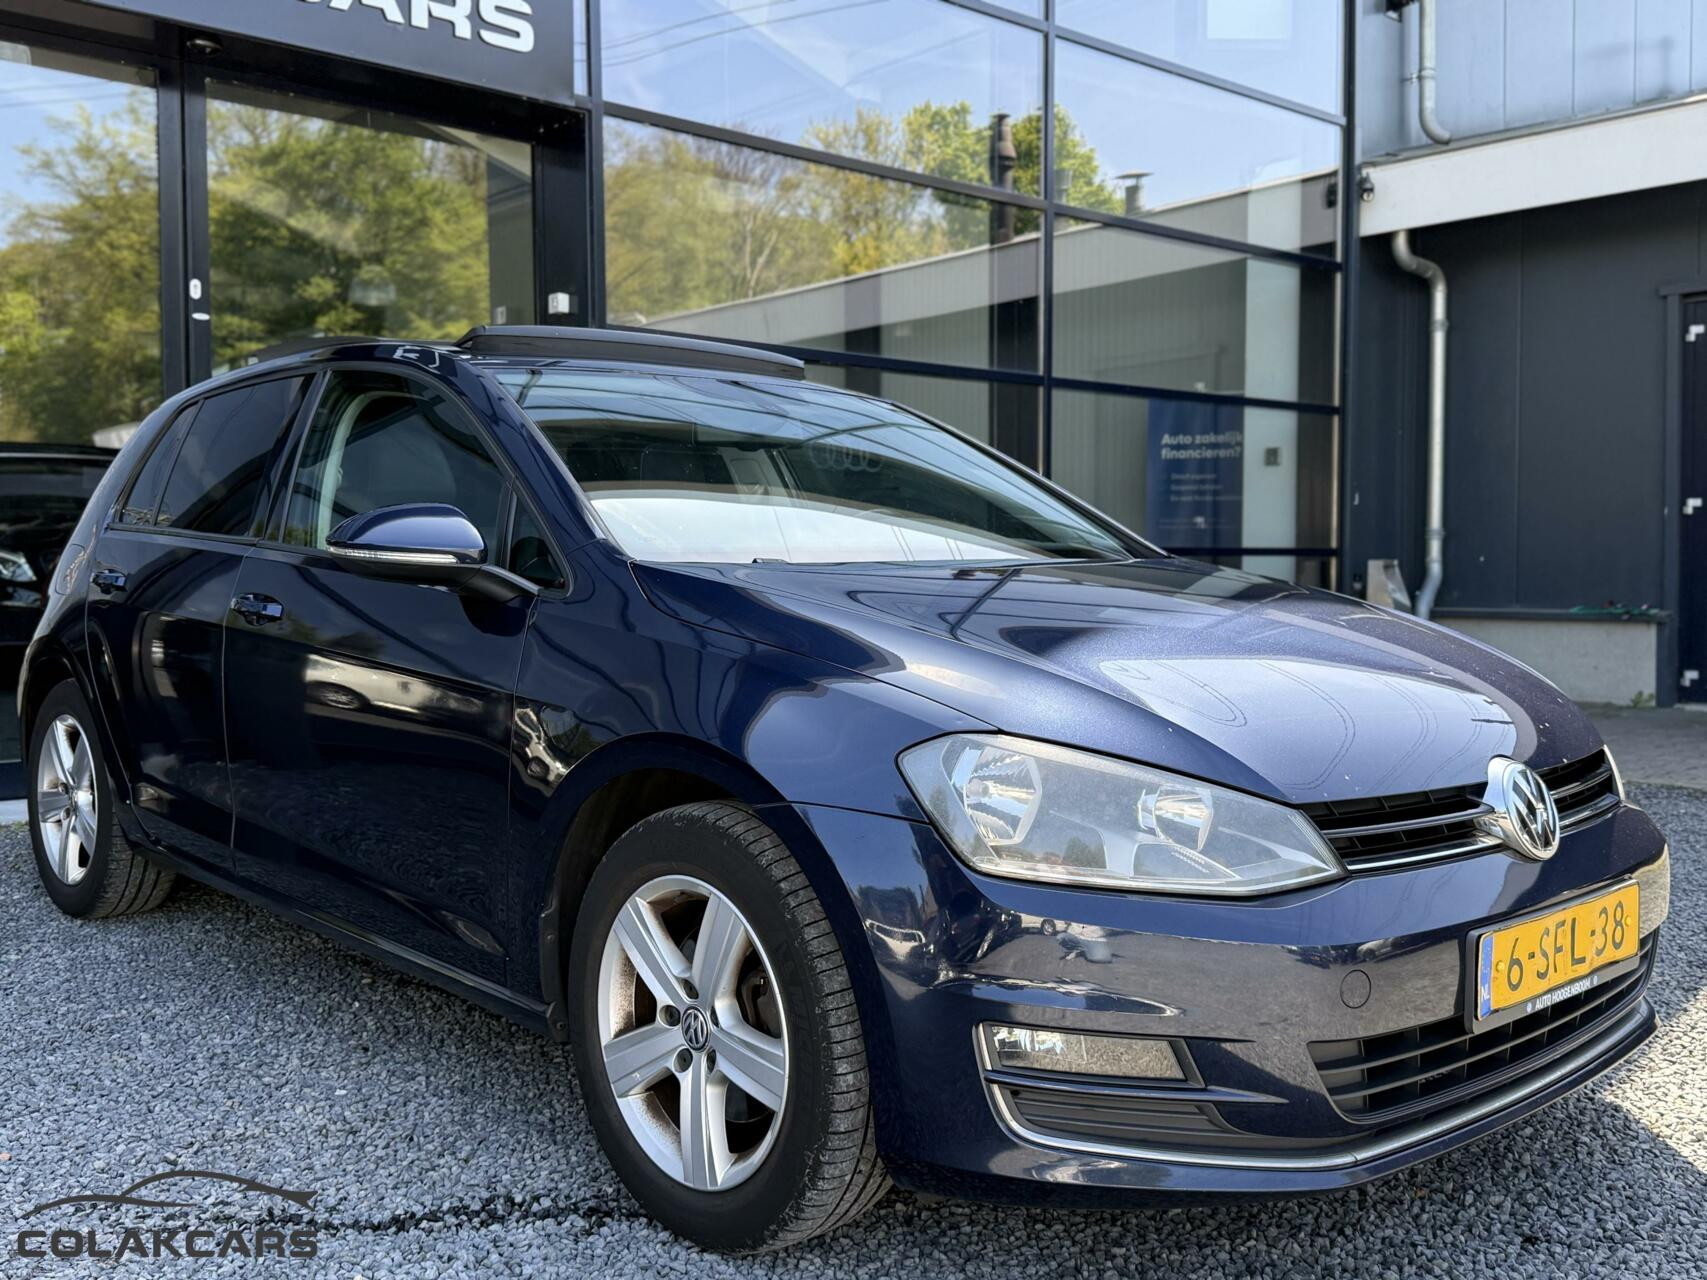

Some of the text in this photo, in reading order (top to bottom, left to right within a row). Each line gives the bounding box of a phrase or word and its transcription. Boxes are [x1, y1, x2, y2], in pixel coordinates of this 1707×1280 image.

[299, 0, 536, 53] RS
[1161, 431, 1243, 446] Auto zakelijk
[1161, 446, 1241, 460] financieren?
[1506, 900, 1626, 992] 6-SFL-38
[1481, 984, 1491, 1003] NL
[1535, 993, 1552, 1011] AUTO
